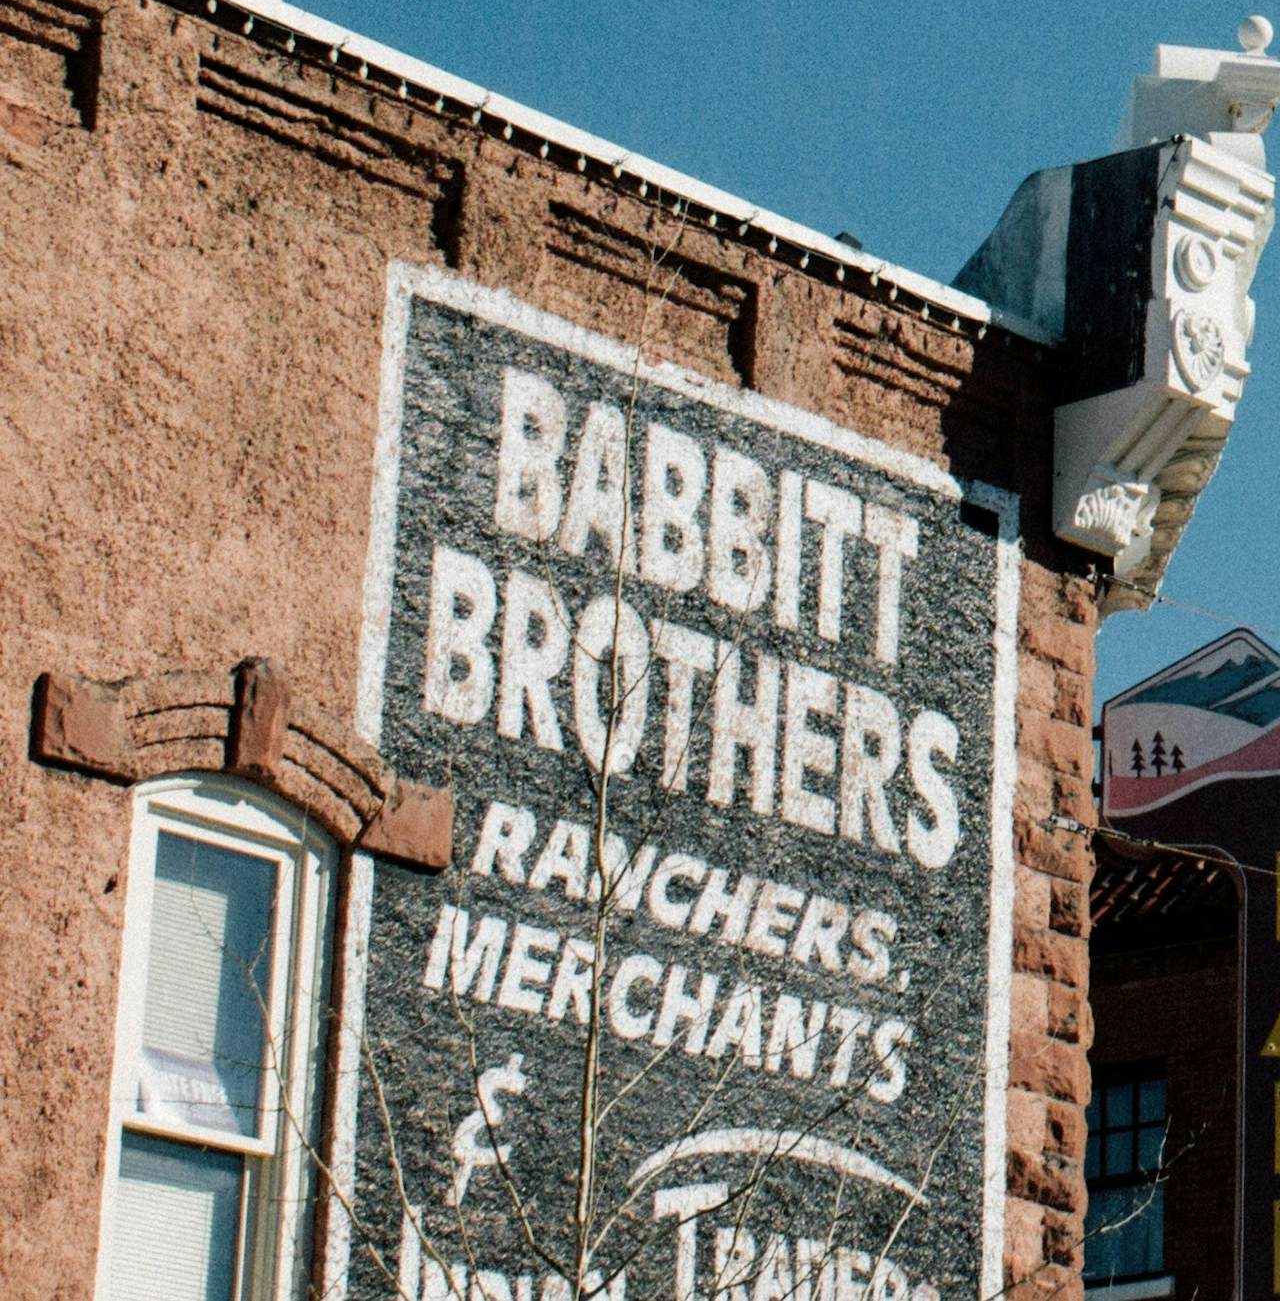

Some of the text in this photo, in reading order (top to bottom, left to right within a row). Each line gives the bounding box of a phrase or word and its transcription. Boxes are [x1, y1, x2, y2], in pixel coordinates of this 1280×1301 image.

[494, 365, 920, 664] BABBITT
[423, 546, 961, 869] BROTHERS
[422, 904, 914, 1103] MERCHANTS
